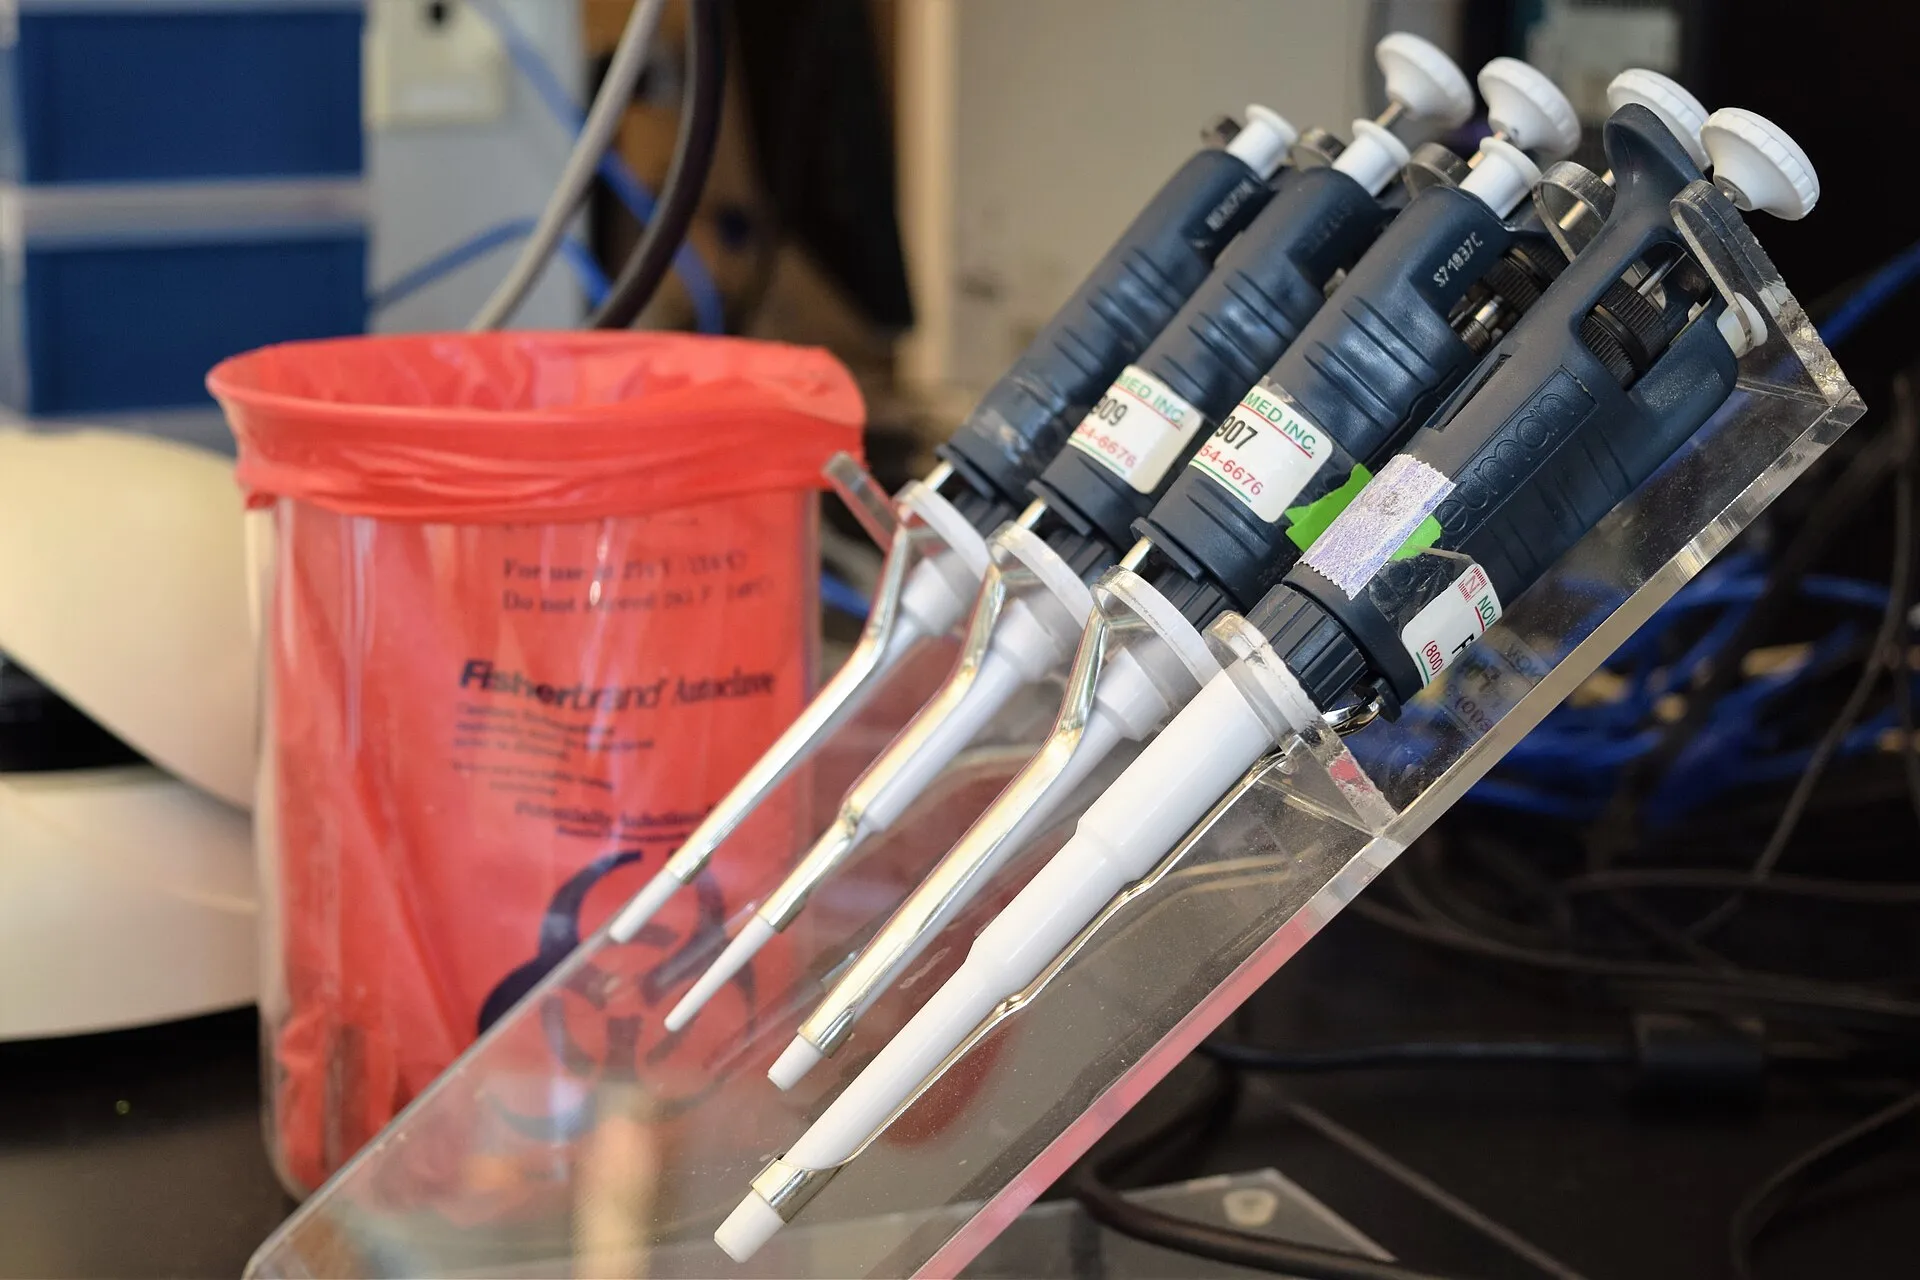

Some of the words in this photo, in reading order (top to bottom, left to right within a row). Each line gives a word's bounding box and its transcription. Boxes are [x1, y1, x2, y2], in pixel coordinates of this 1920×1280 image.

[1153, 393, 1184, 429] INC.
[1244, 392, 1283, 423] MED
[1283, 419, 1316, 456] INC.
[1421, 640, 1445, 677] (800)
